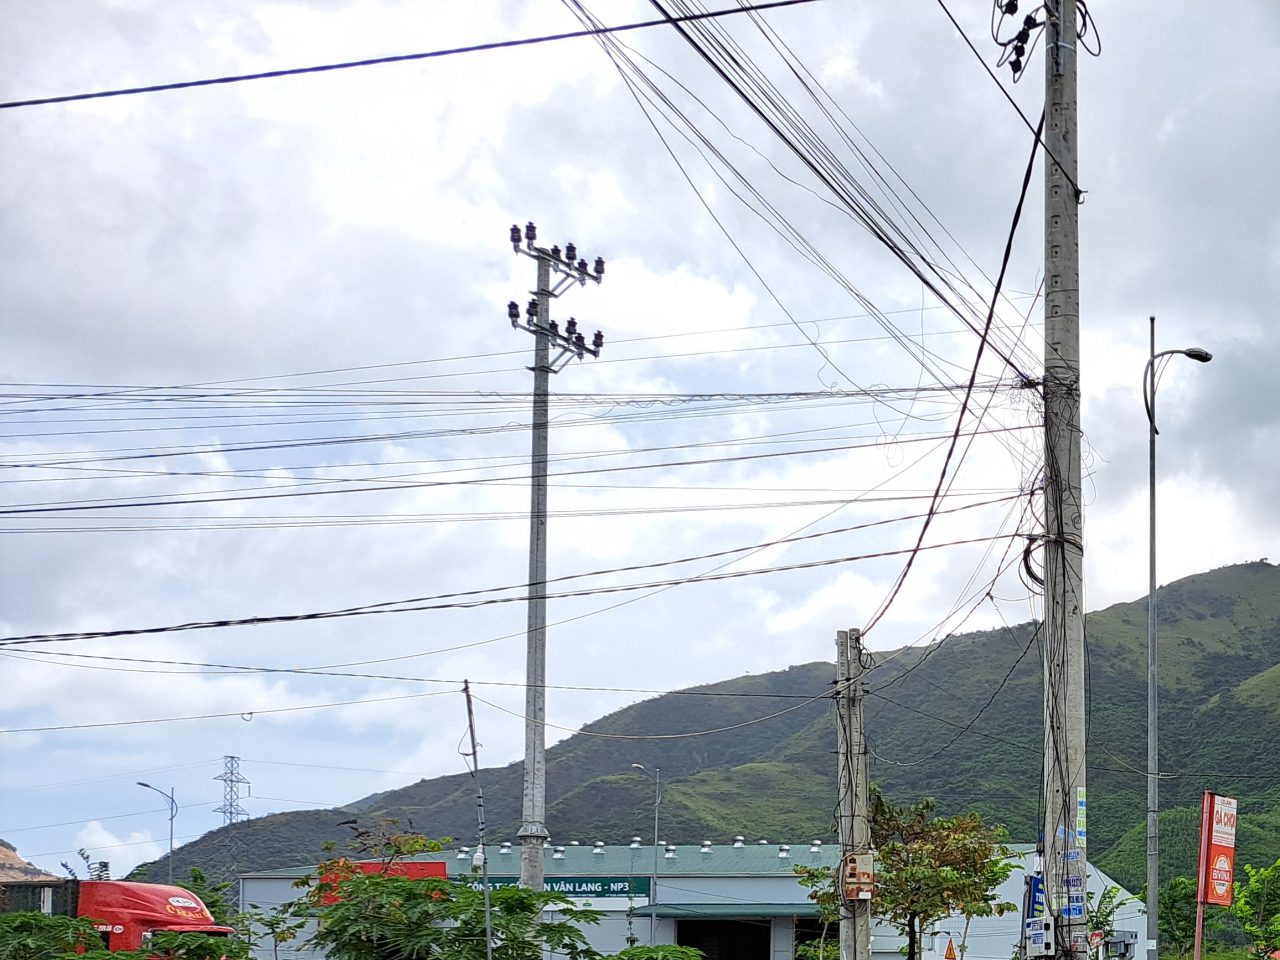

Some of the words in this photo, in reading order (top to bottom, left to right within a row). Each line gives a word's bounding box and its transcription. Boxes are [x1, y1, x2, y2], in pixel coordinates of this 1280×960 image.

[1212, 869, 1230, 881] BIVINA
[553, 881, 575, 892] VĂN
[575, 883, 602, 892] LANG
[610, 883, 630, 891] NP3
